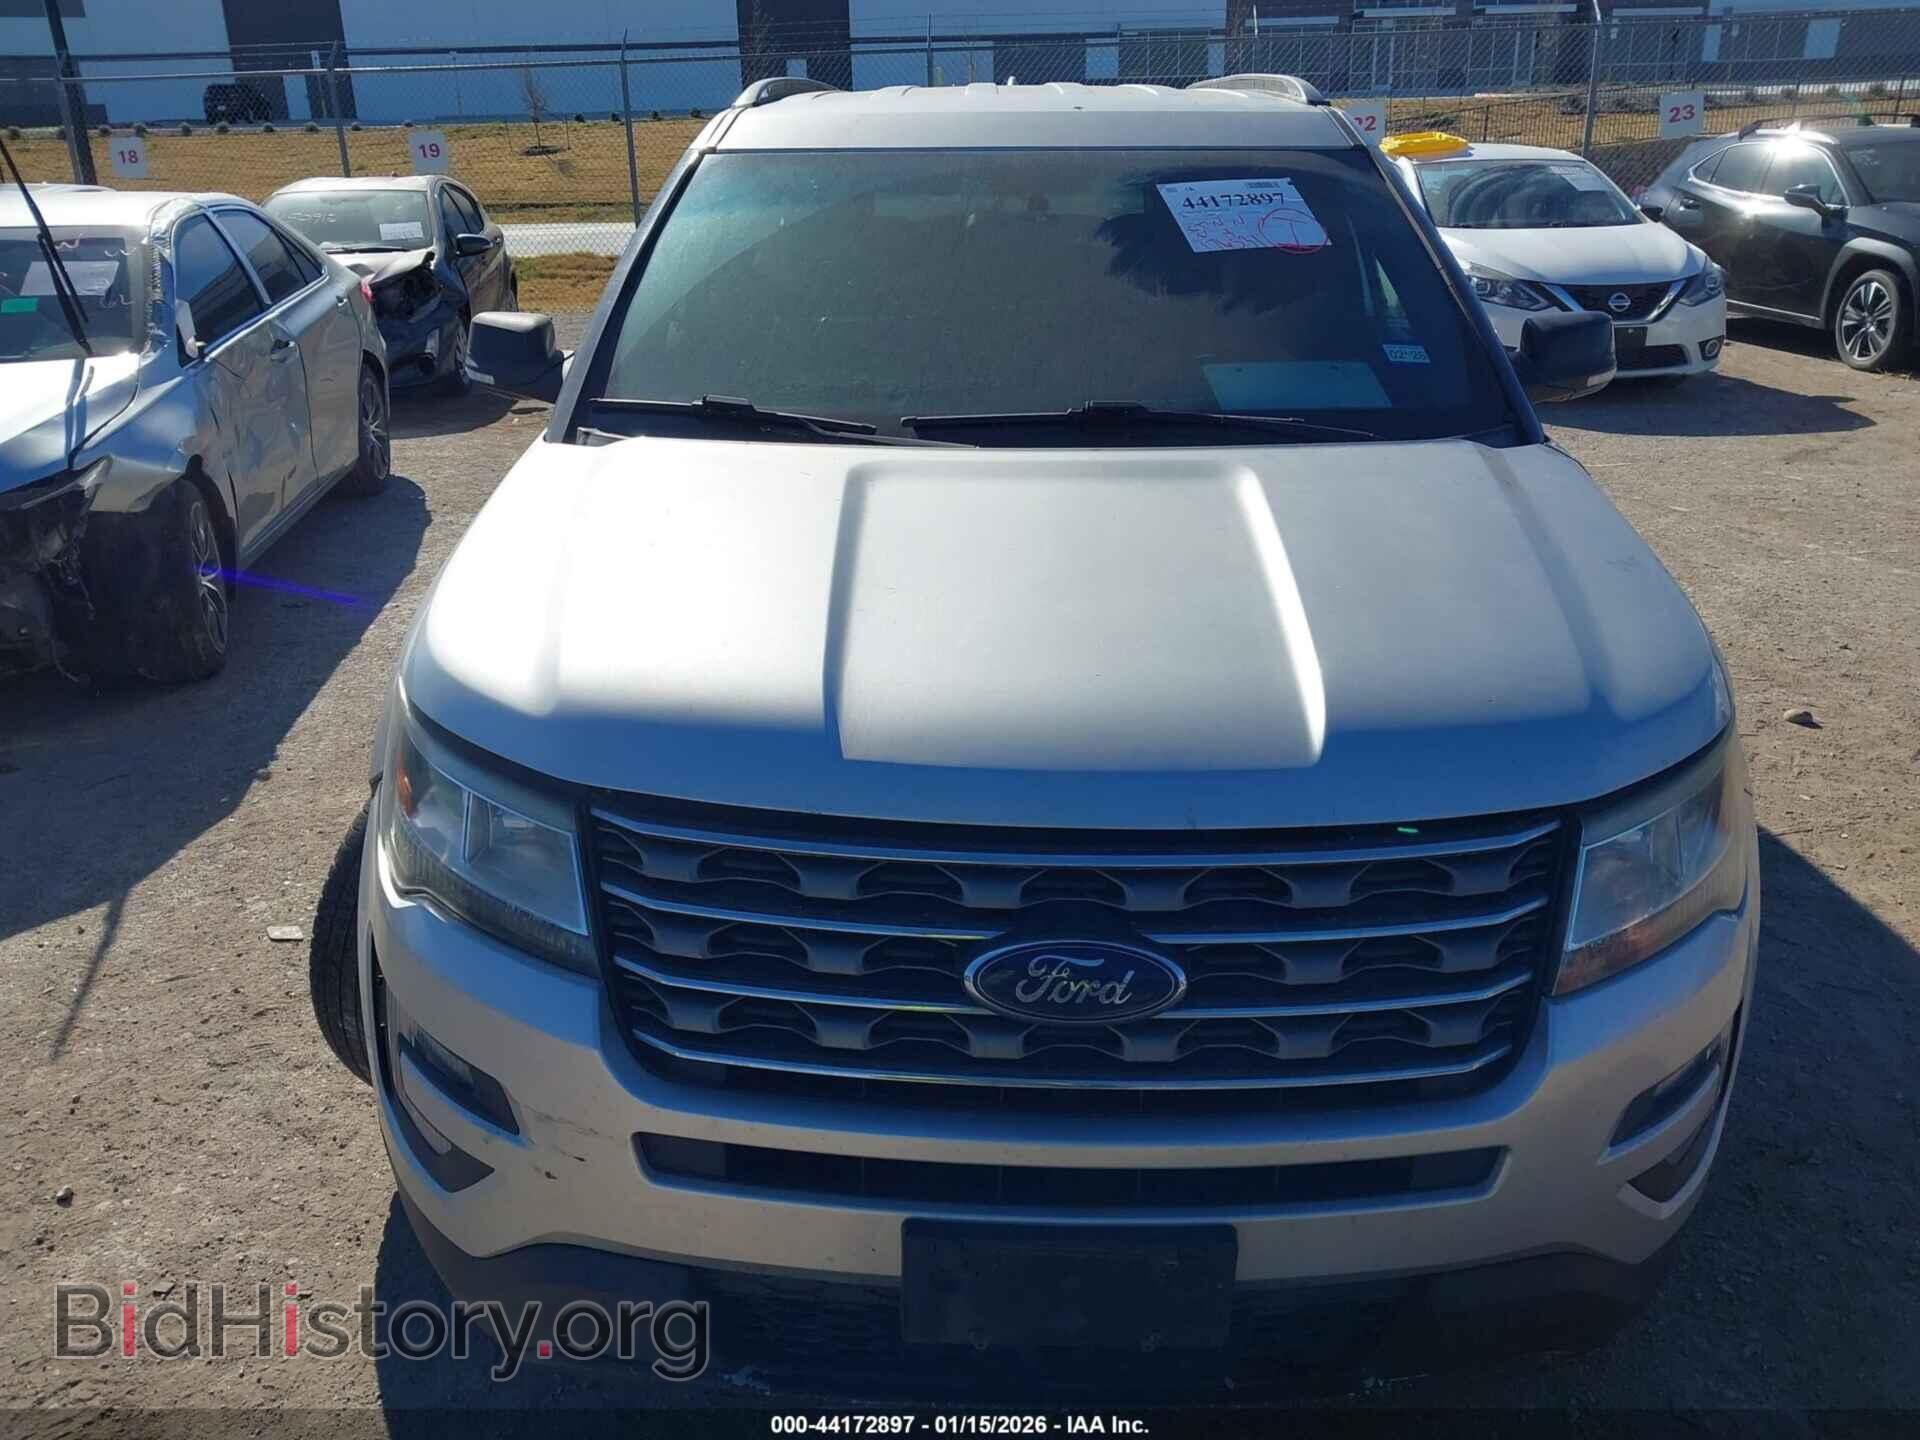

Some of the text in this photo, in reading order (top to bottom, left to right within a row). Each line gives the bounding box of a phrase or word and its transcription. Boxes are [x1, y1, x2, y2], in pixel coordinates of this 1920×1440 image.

[1669, 104, 1696, 123] 23
[118, 150, 139, 165] 18
[419, 143, 440, 159] 19
[1182, 192, 1284, 209] 44172897
[1015, 954, 1135, 1005] Ford
